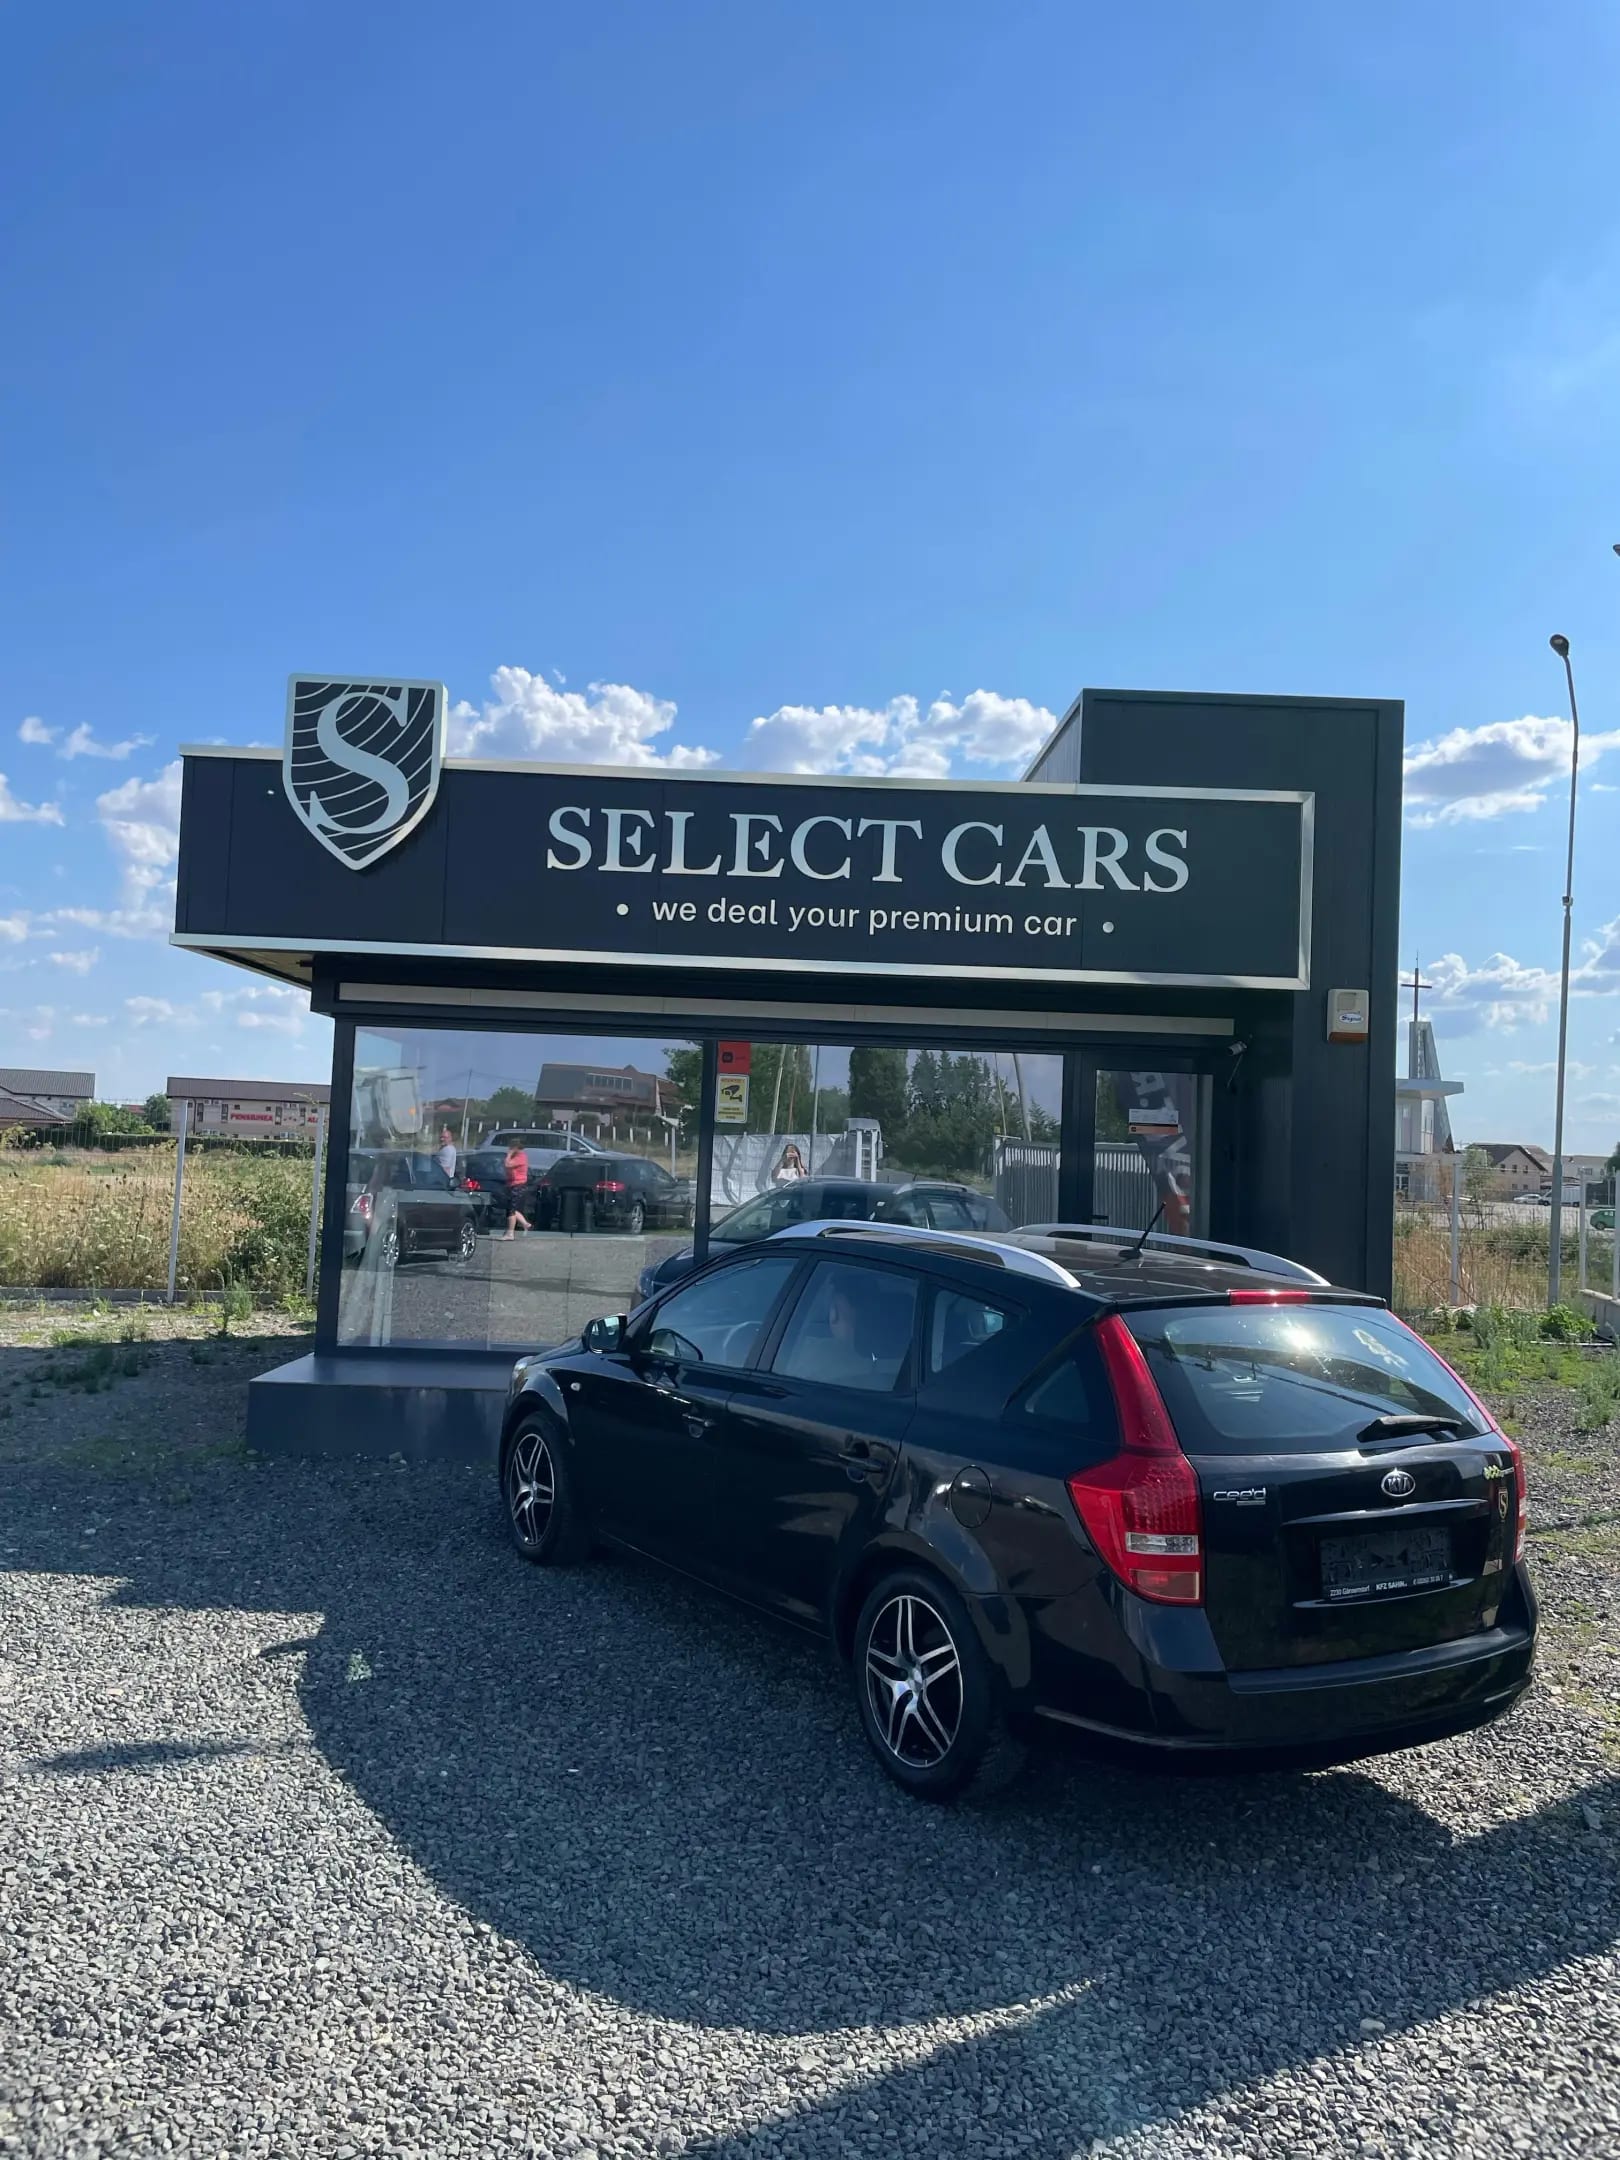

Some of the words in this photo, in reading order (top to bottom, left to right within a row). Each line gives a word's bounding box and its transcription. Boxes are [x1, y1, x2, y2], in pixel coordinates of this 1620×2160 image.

[309, 687, 410, 834] S
[546, 806, 923, 883] SELECT
[941, 821, 1190, 893] CARS
[652, 900, 697, 922] we
[707, 897, 778, 925] deal
[788, 906, 860, 932] your
[869, 905, 1013, 936] premium
[1024, 915, 1078, 936] car
